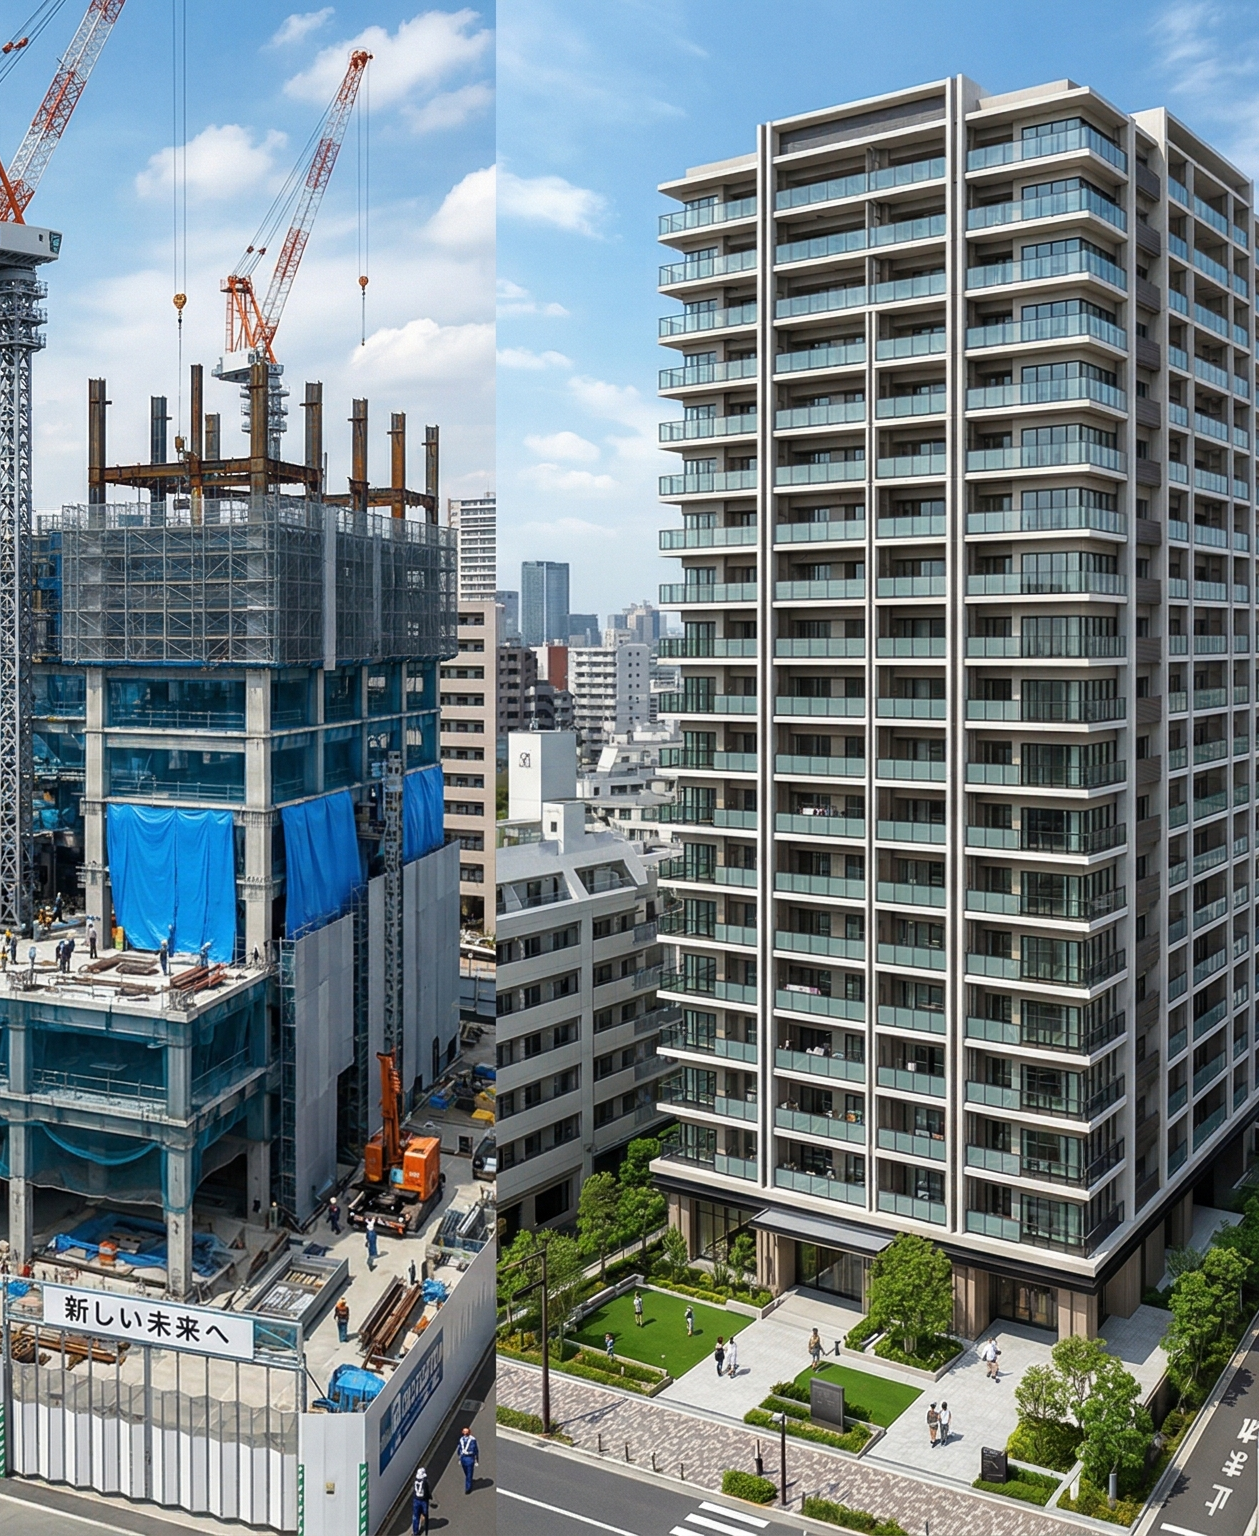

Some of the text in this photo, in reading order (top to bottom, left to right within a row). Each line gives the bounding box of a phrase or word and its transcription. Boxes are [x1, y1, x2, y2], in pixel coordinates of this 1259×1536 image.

[64, 1295, 229, 1344] 新しい未来へ
